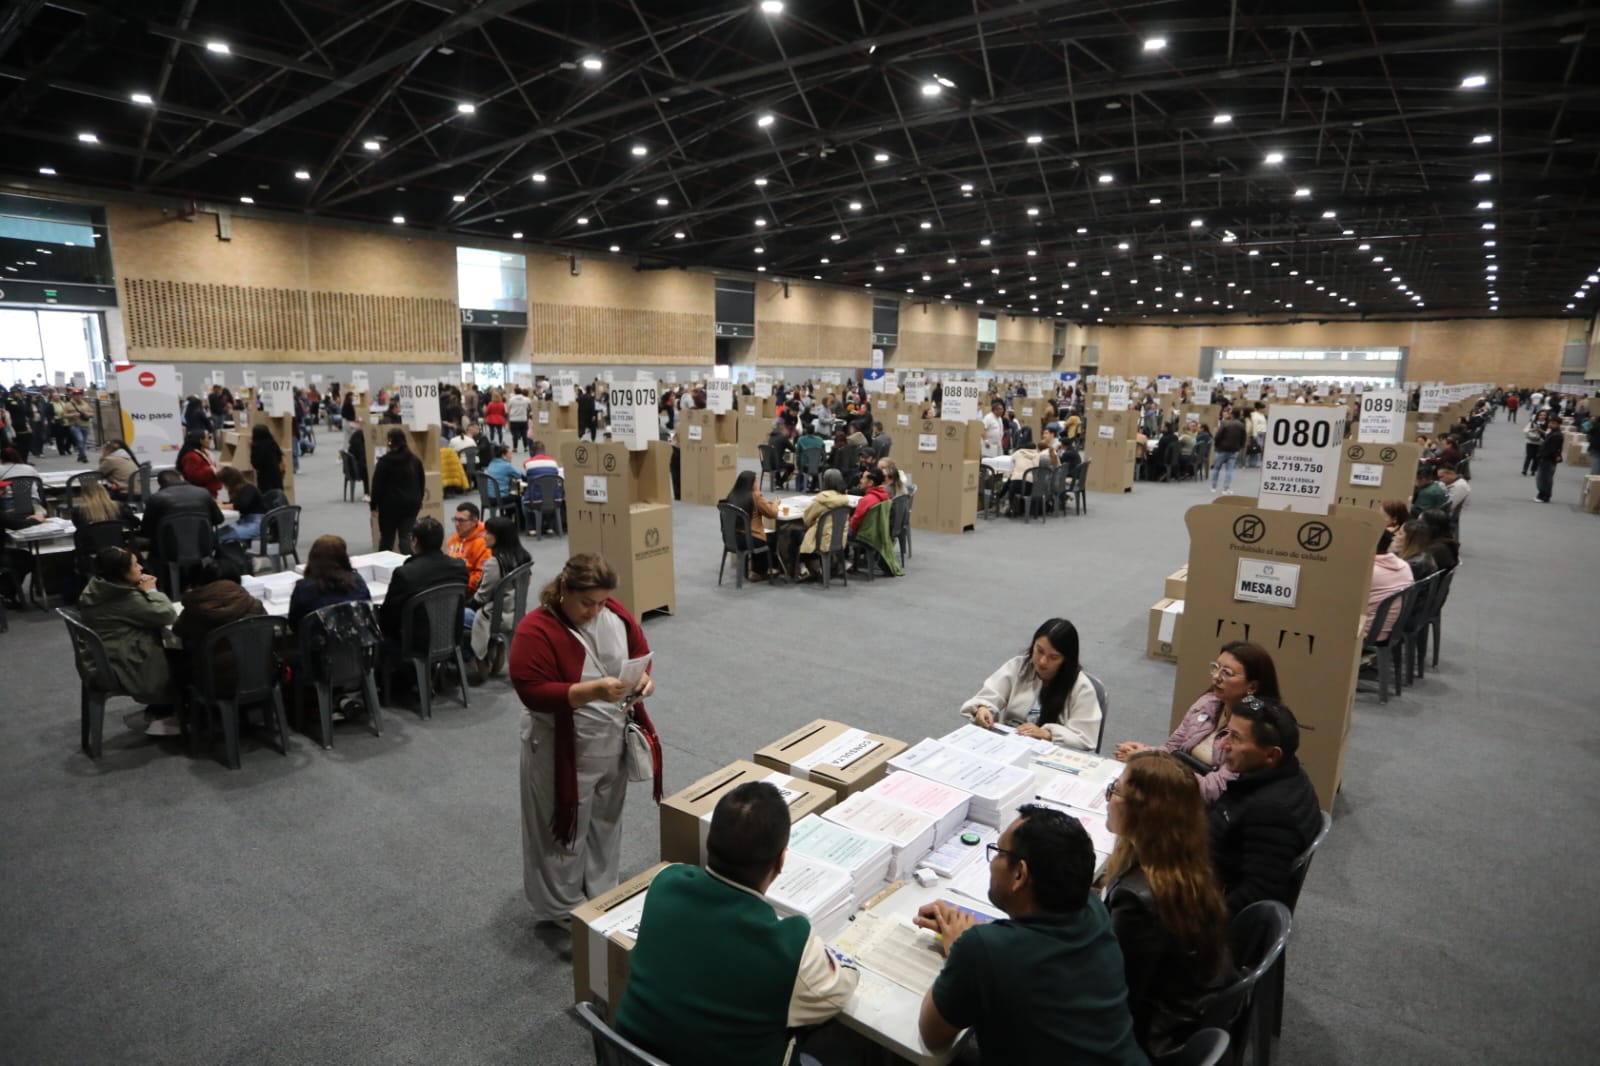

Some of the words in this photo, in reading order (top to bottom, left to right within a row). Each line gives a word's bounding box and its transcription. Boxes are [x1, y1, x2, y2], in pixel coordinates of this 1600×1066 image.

[461, 309, 474, 322] 15
[272, 380, 291, 391] 077
[415, 384, 438, 398] 078
[944, 386, 962, 397] 088
[964, 386, 978, 398] 088
[611, 389, 634, 406] 079
[635, 388, 656, 405] 079
[1424, 389, 1440, 398] 107
[1364, 398, 1393, 412] 089
[149, 412, 174, 421] pase
[1272, 418, 1331, 448] 080
[1265, 460, 1323, 474] 52.719.750
[1263, 481, 1321, 495] 52.721.637
[1229, 543, 1265, 554] Prohibido
[1266, 547, 1274, 556] el
[1275, 549, 1289, 557] uso
[1289, 551, 1300, 559] de
[1301, 552, 1328, 562] celular
[1241, 580, 1273, 596] MESA
[1274, 586, 1292, 598] 80
[831, 740, 872, 765] CONSULTA
